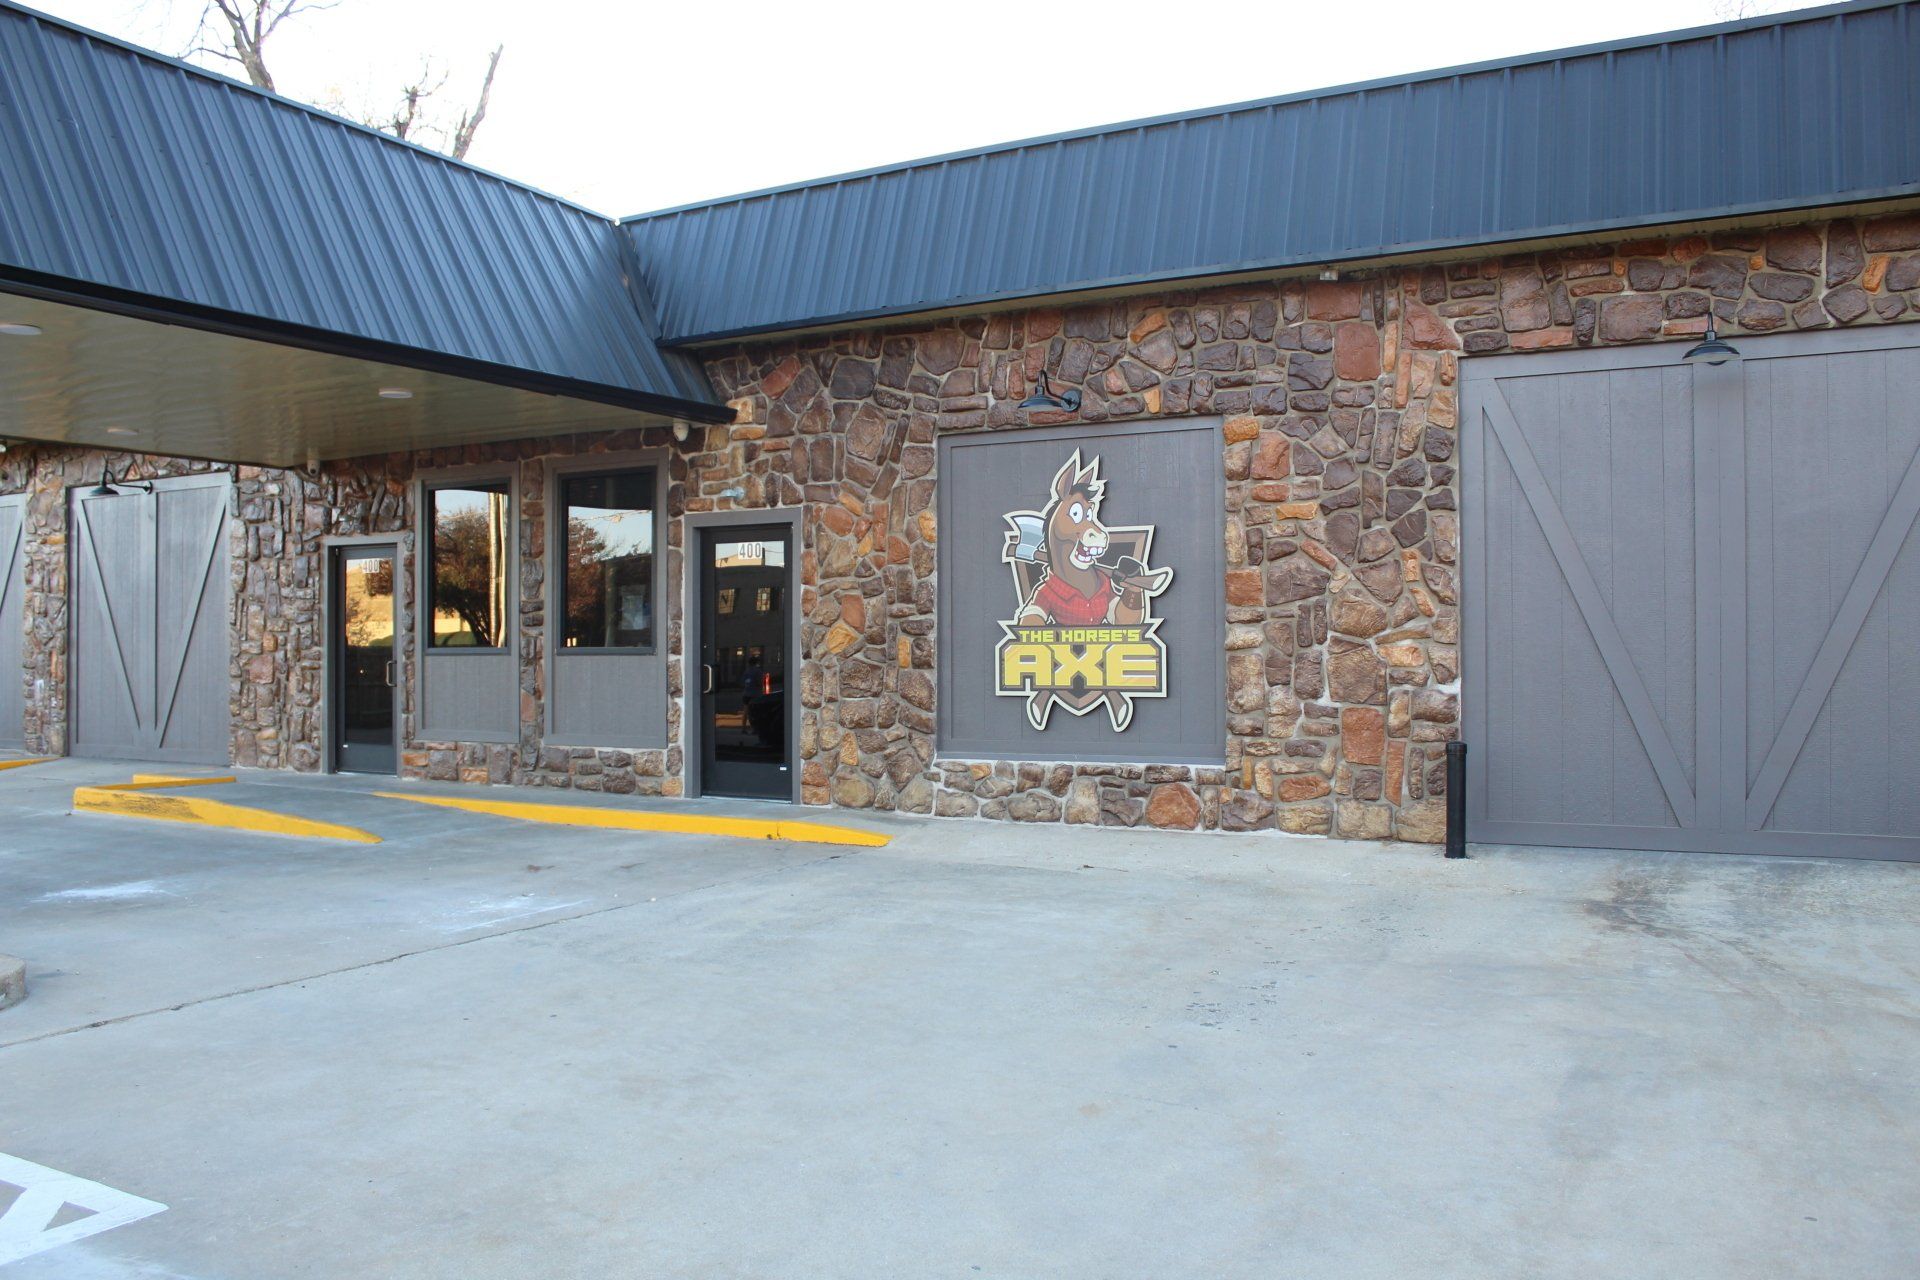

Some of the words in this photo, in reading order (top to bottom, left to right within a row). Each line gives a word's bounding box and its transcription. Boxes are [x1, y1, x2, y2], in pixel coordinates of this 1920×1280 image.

[739, 543, 761, 558] 400
[362, 559, 379, 572] 400
[1018, 629, 1053, 643] THE
[1061, 629, 1141, 643] HORSE'S
[1004, 644, 1157, 686] AXE
